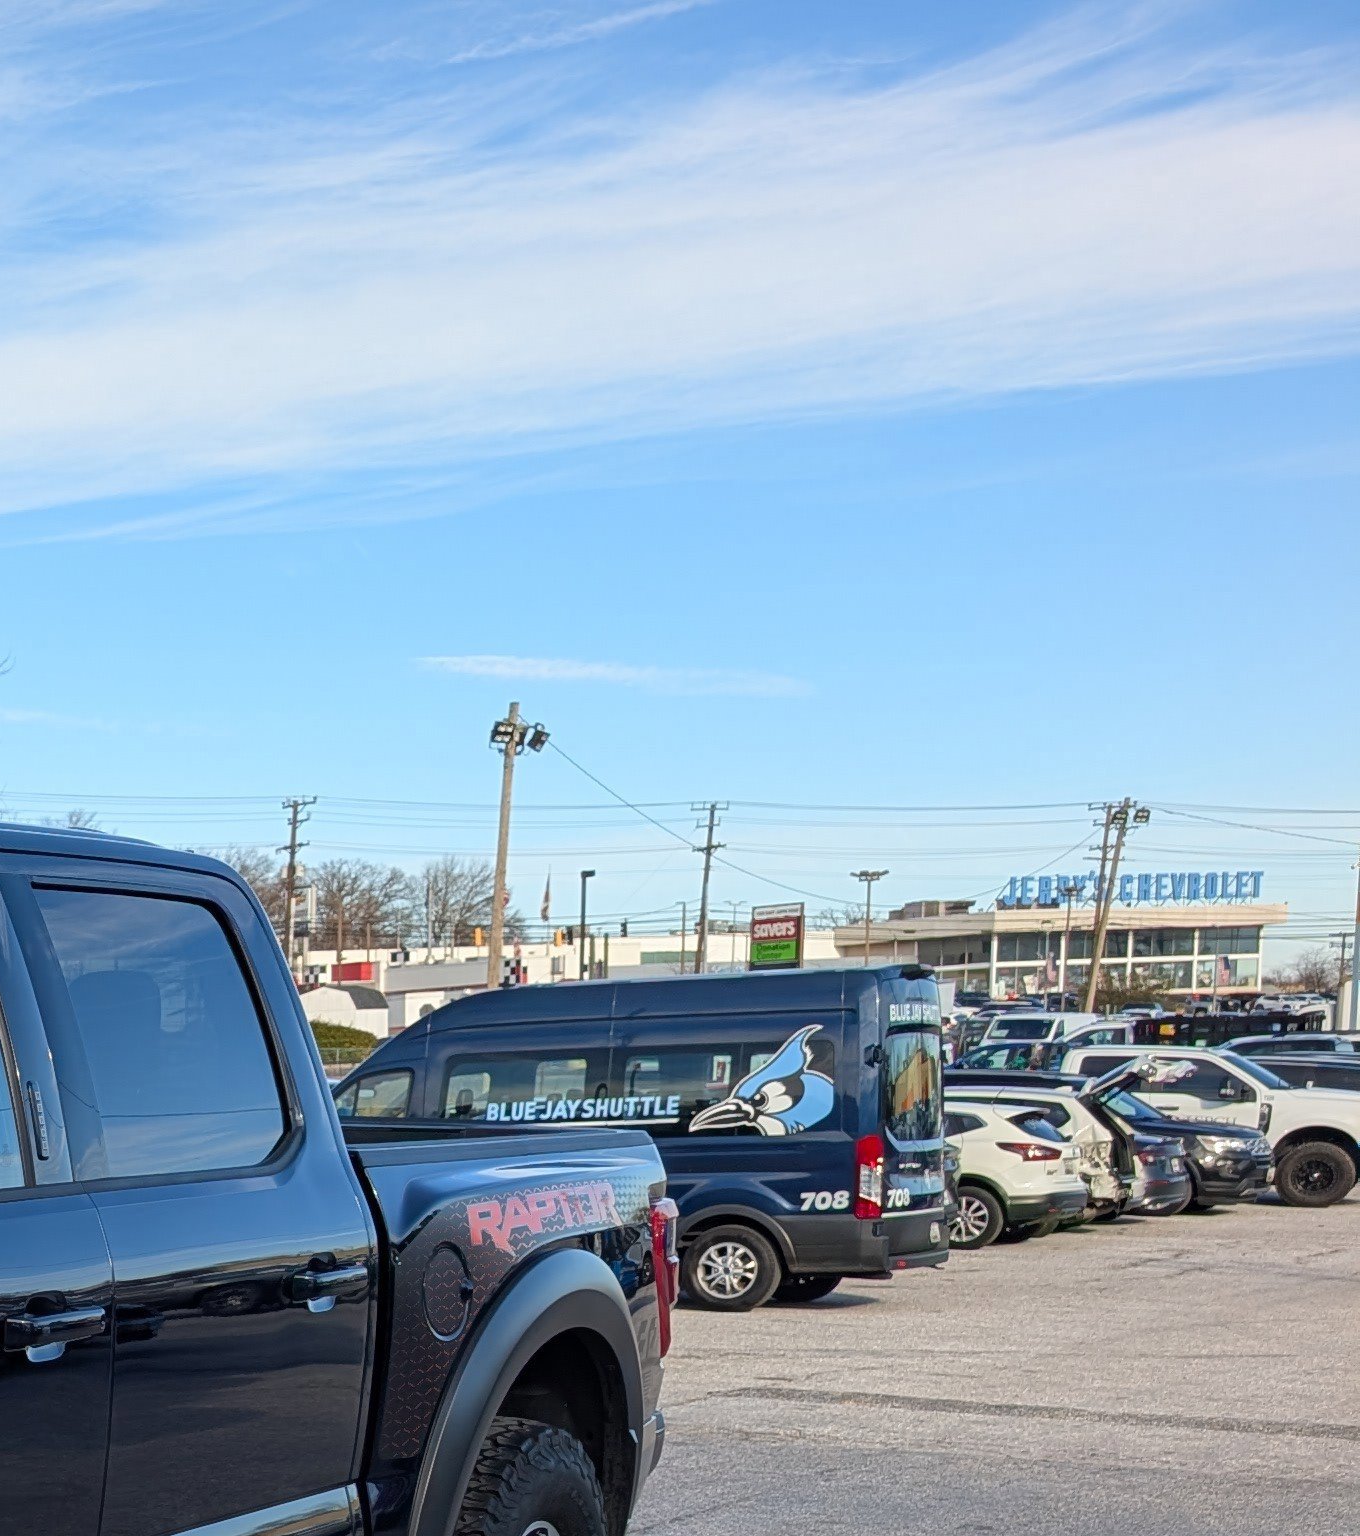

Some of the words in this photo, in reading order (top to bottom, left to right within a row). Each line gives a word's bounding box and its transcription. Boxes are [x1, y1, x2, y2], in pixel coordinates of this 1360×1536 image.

[1119, 871, 1264, 901] CHEVROLET
[486, 1101, 537, 1122] BLUE
[538, 1099, 581, 1120] JAY
[581, 1095, 680, 1119] SHUTTLE
[800, 1190, 850, 1211] 708
[886, 1187, 911, 1209] 708
[467, 1182, 623, 1258] RAPTOR
